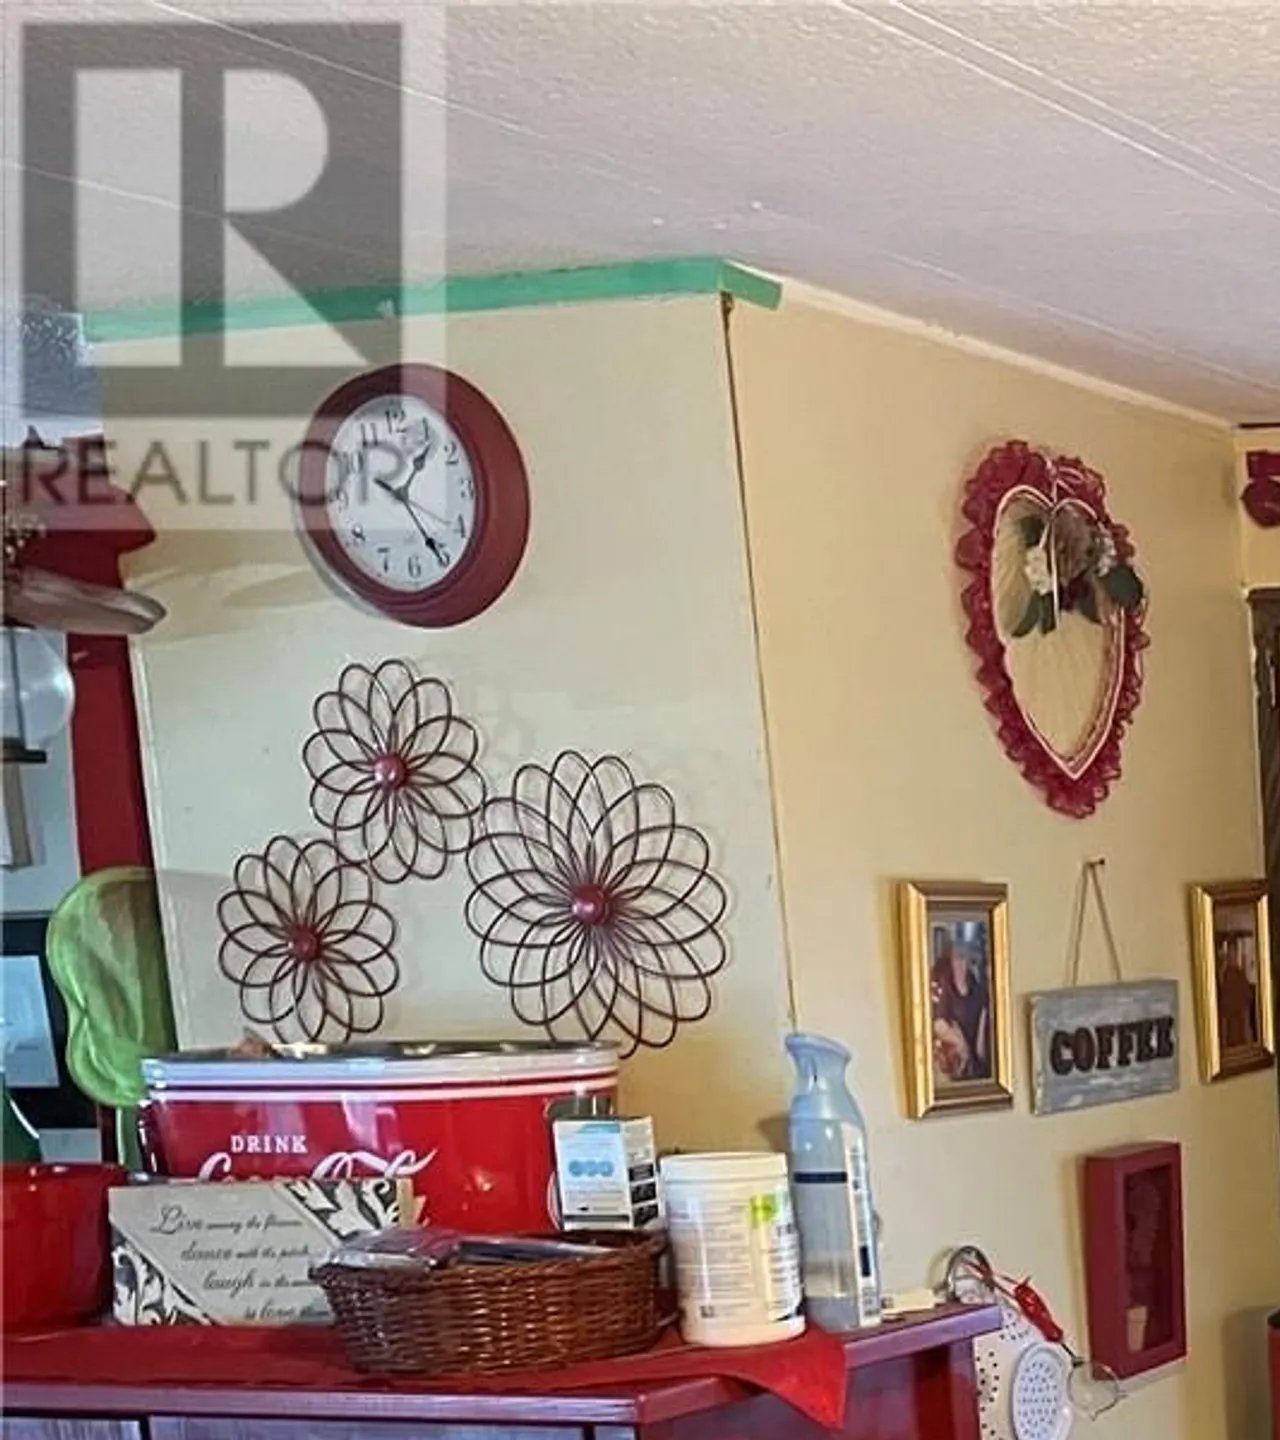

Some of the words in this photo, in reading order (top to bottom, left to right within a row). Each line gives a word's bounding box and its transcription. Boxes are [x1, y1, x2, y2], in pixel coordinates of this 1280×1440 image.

[385, 408, 407, 435] 12
[422, 417, 431, 441] 1
[361, 422, 379, 447] 11
[344, 450, 364, 474] 10
[443, 441, 460, 466] 2
[336, 488, 349, 512] 9
[460, 479, 475, 500] 3
[352, 524, 366, 543] 8
[453, 514, 467, 539] 4
[377, 546, 391, 573] 7
[407, 555, 422, 579] 6
[1051, 1015, 1174, 1076] COFFEE
[230, 1134, 309, 1154] DRINK
[150, 1204, 203, 1235] Live
